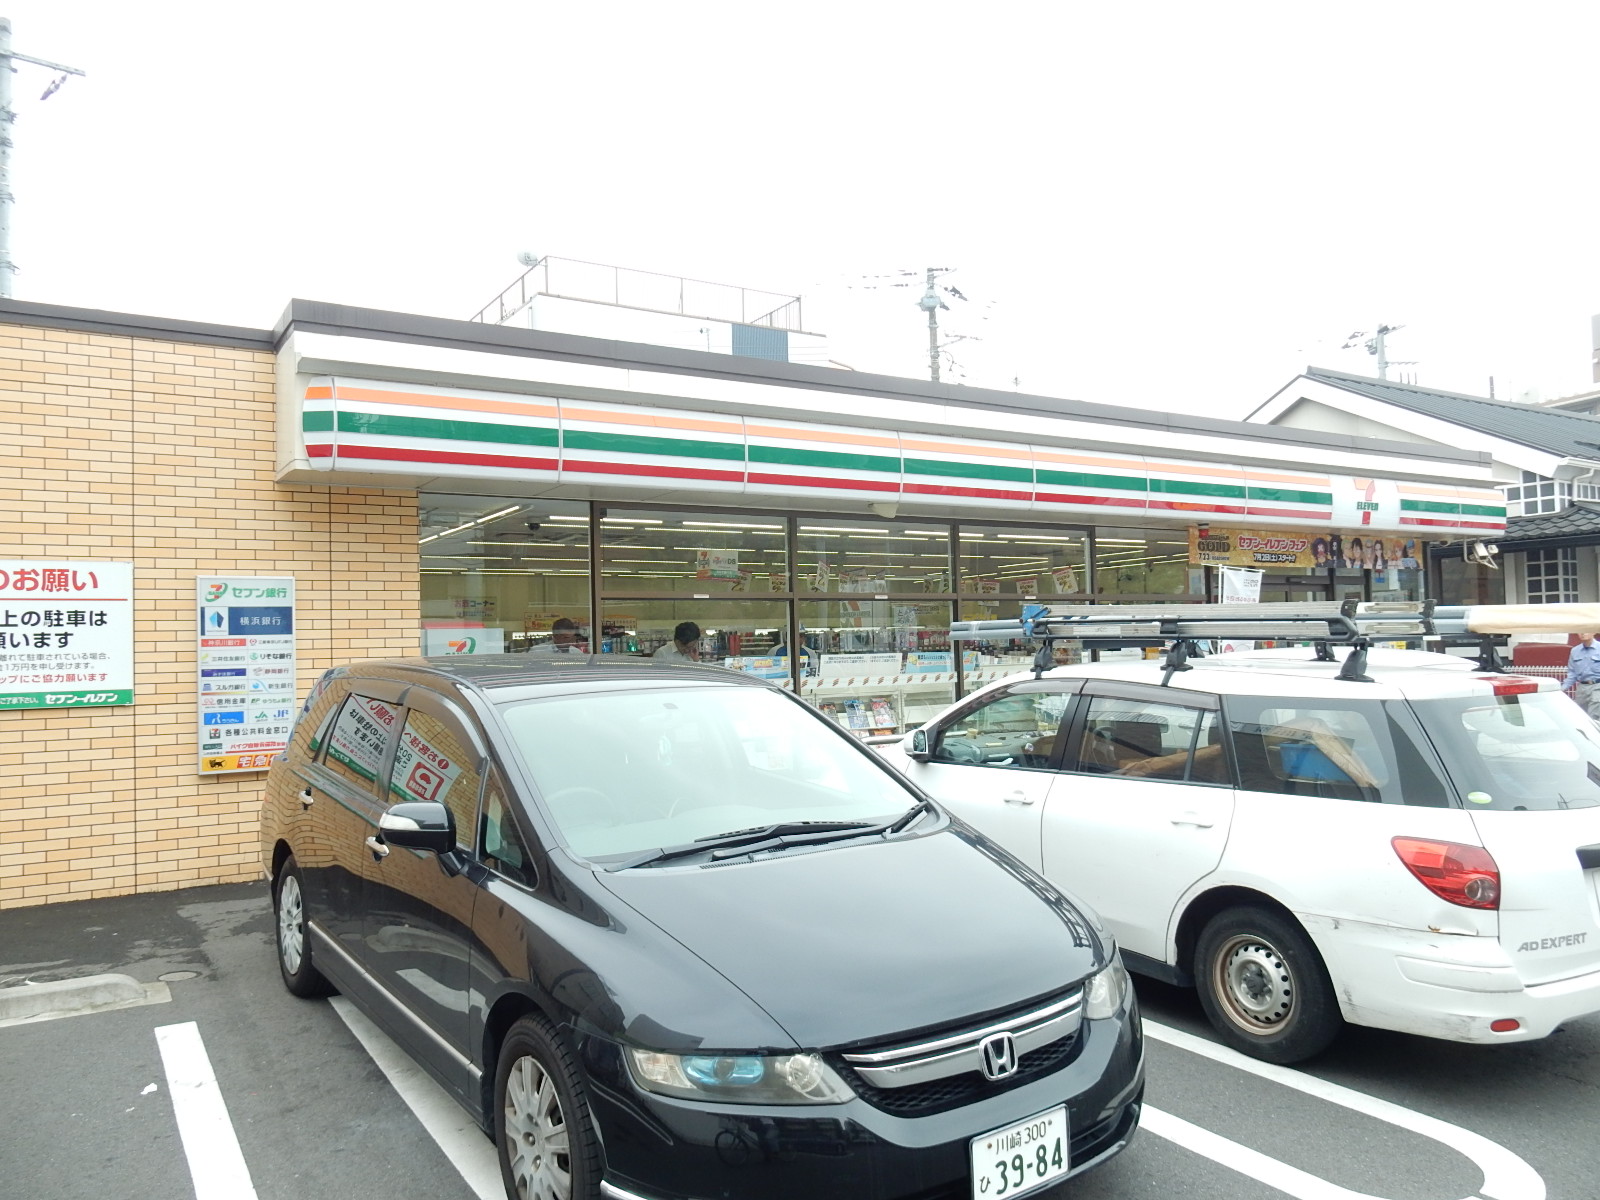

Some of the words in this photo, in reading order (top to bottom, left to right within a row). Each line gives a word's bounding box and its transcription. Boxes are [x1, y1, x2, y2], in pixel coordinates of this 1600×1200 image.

[231, 587, 288, 599] セブン銀行
[0, 609, 108, 628] 上の駐車は
[239, 616, 282, 626] 横浜銀行
[0, 662, 95, 672] 1万円を申し受けます。
[216, 697, 246, 705] 信用金庫
[225, 726, 289, 737] 各種公共料金窓口
[1516, 941, 1539, 953] AD
[1540, 932, 1587, 950] EXPERT
[995, 1130, 1022, 1155] 川崎
[1024, 1120, 1047, 1144] 300
[979, 1175, 991, 1194] ひ
[995, 1136, 1063, 1195] 39-84
